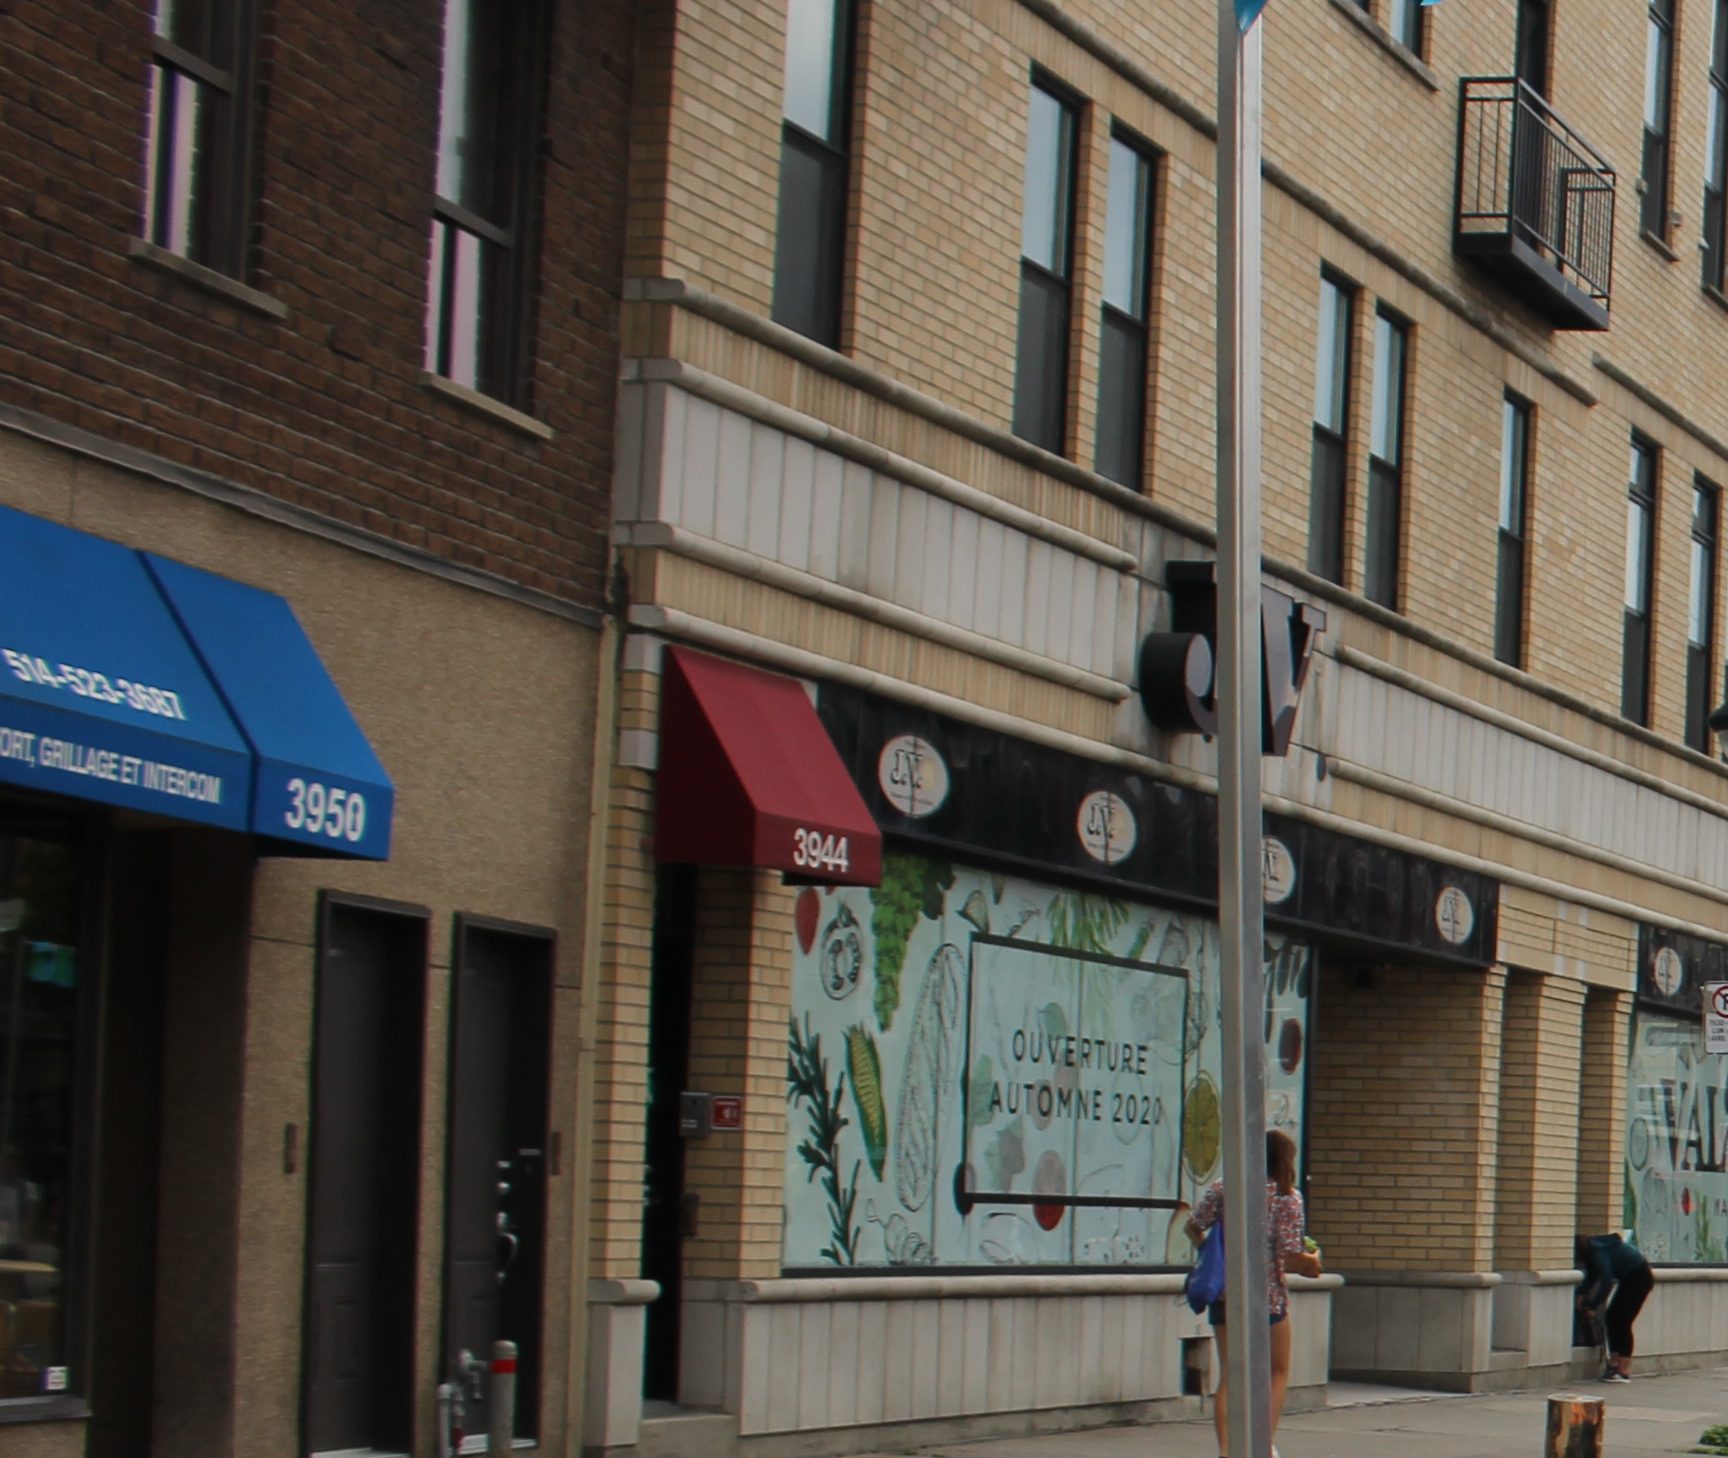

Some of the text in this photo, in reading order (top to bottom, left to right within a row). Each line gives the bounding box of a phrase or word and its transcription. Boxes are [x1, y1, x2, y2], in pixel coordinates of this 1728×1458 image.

[1, 648, 190, 721] 514-523-3687
[40, 736, 119, 781] GRILLAGE
[119, 752, 138, 786] ET
[142, 760, 222, 804] INTERCOM
[284, 777, 366, 842] 3950
[792, 828, 849, 873] 3944
[1012, 1028, 1149, 1075] OUVERTURE
[989, 1080, 1163, 1126] AUTOMNE 2020
